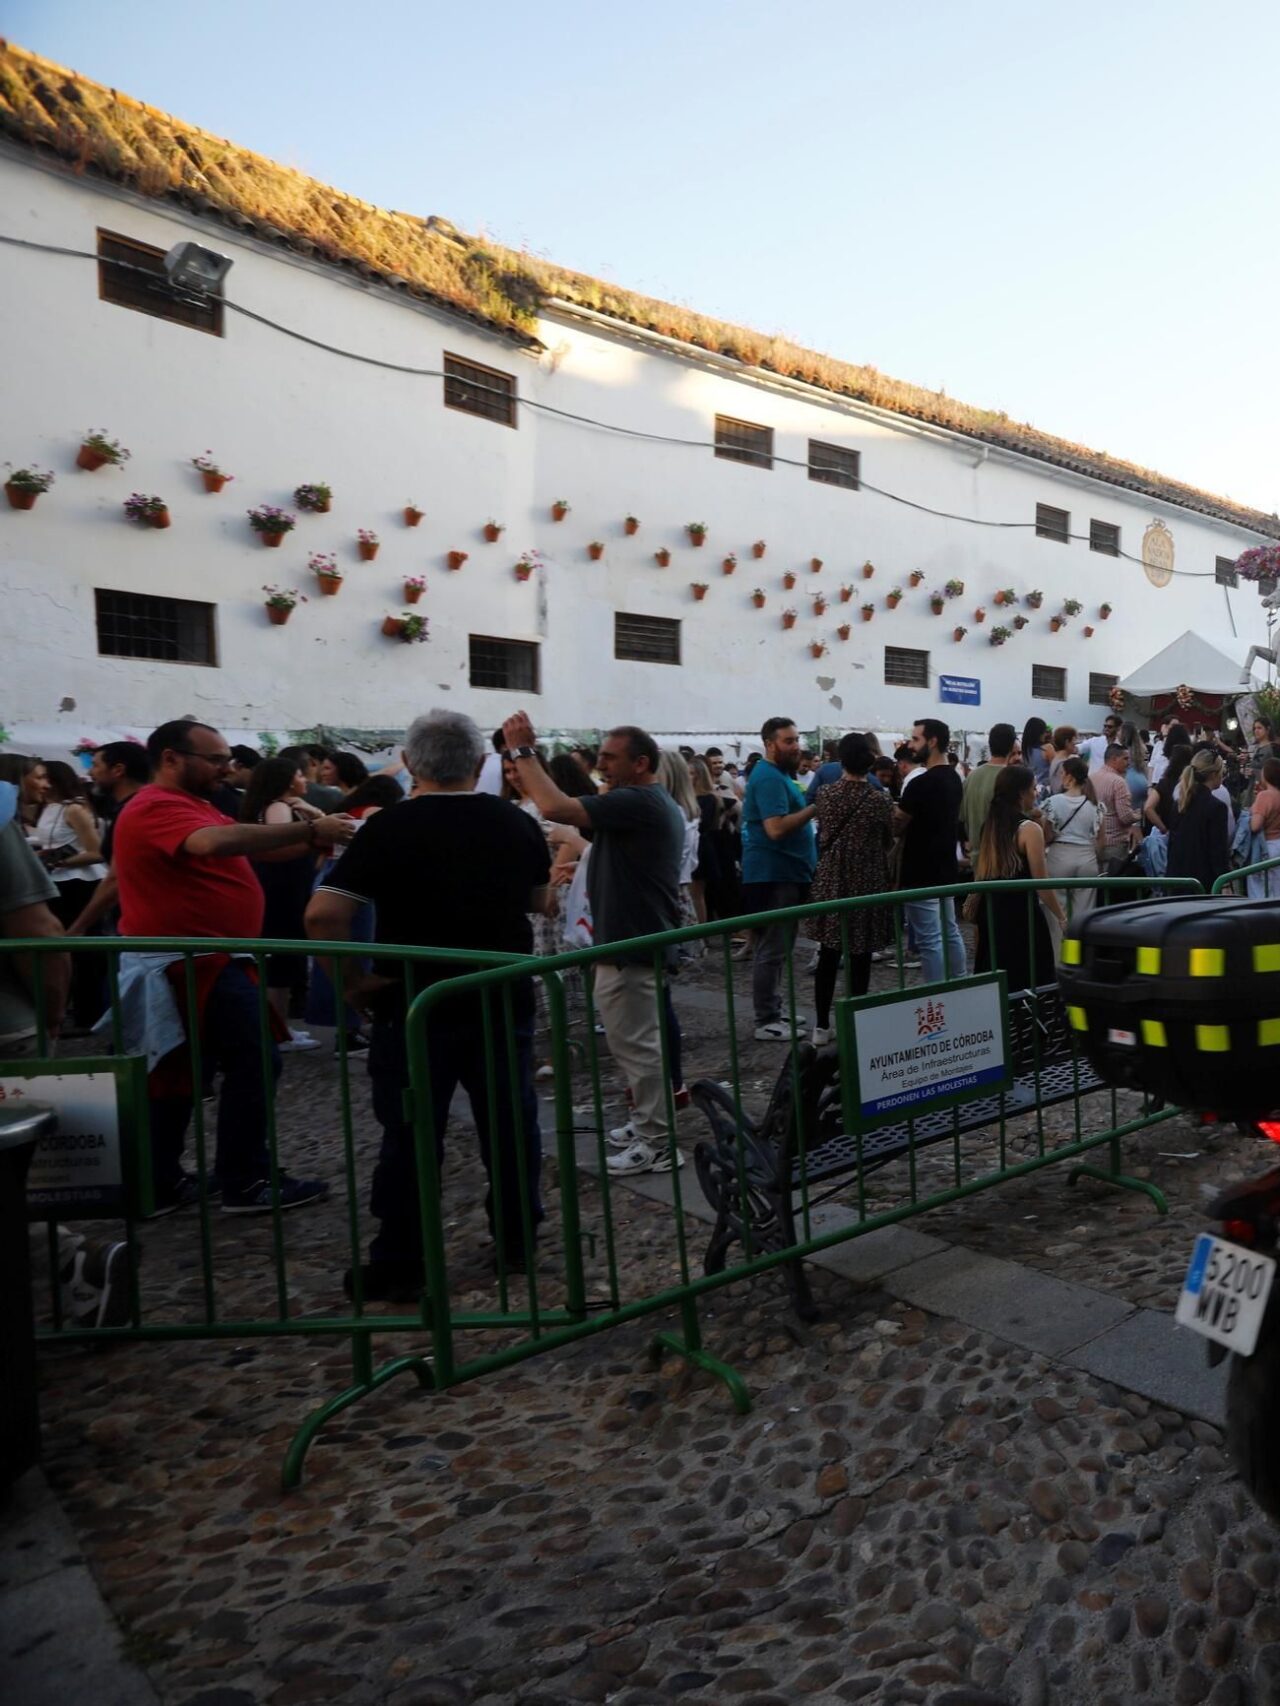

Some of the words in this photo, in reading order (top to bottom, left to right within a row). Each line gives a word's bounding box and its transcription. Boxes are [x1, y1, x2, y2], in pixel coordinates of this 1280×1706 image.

[869, 1043, 938, 1071] AYUNTAMIENTO
[940, 1041, 951, 1053] DE
[953, 1030, 994, 1050] CÓRDOBA
[881, 1067, 904, 1081] Área
[907, 1064, 919, 1075] de
[921, 1047, 992, 1070] Infraestructuras
[876, 1091, 920, 1110] PERDONEN
[921, 1086, 936, 1098] LAS
[937, 1075, 977, 1093] MOLESTIAS
[902, 1076, 928, 1089] Equipo
[1206, 1247, 1265, 1299] 5200
